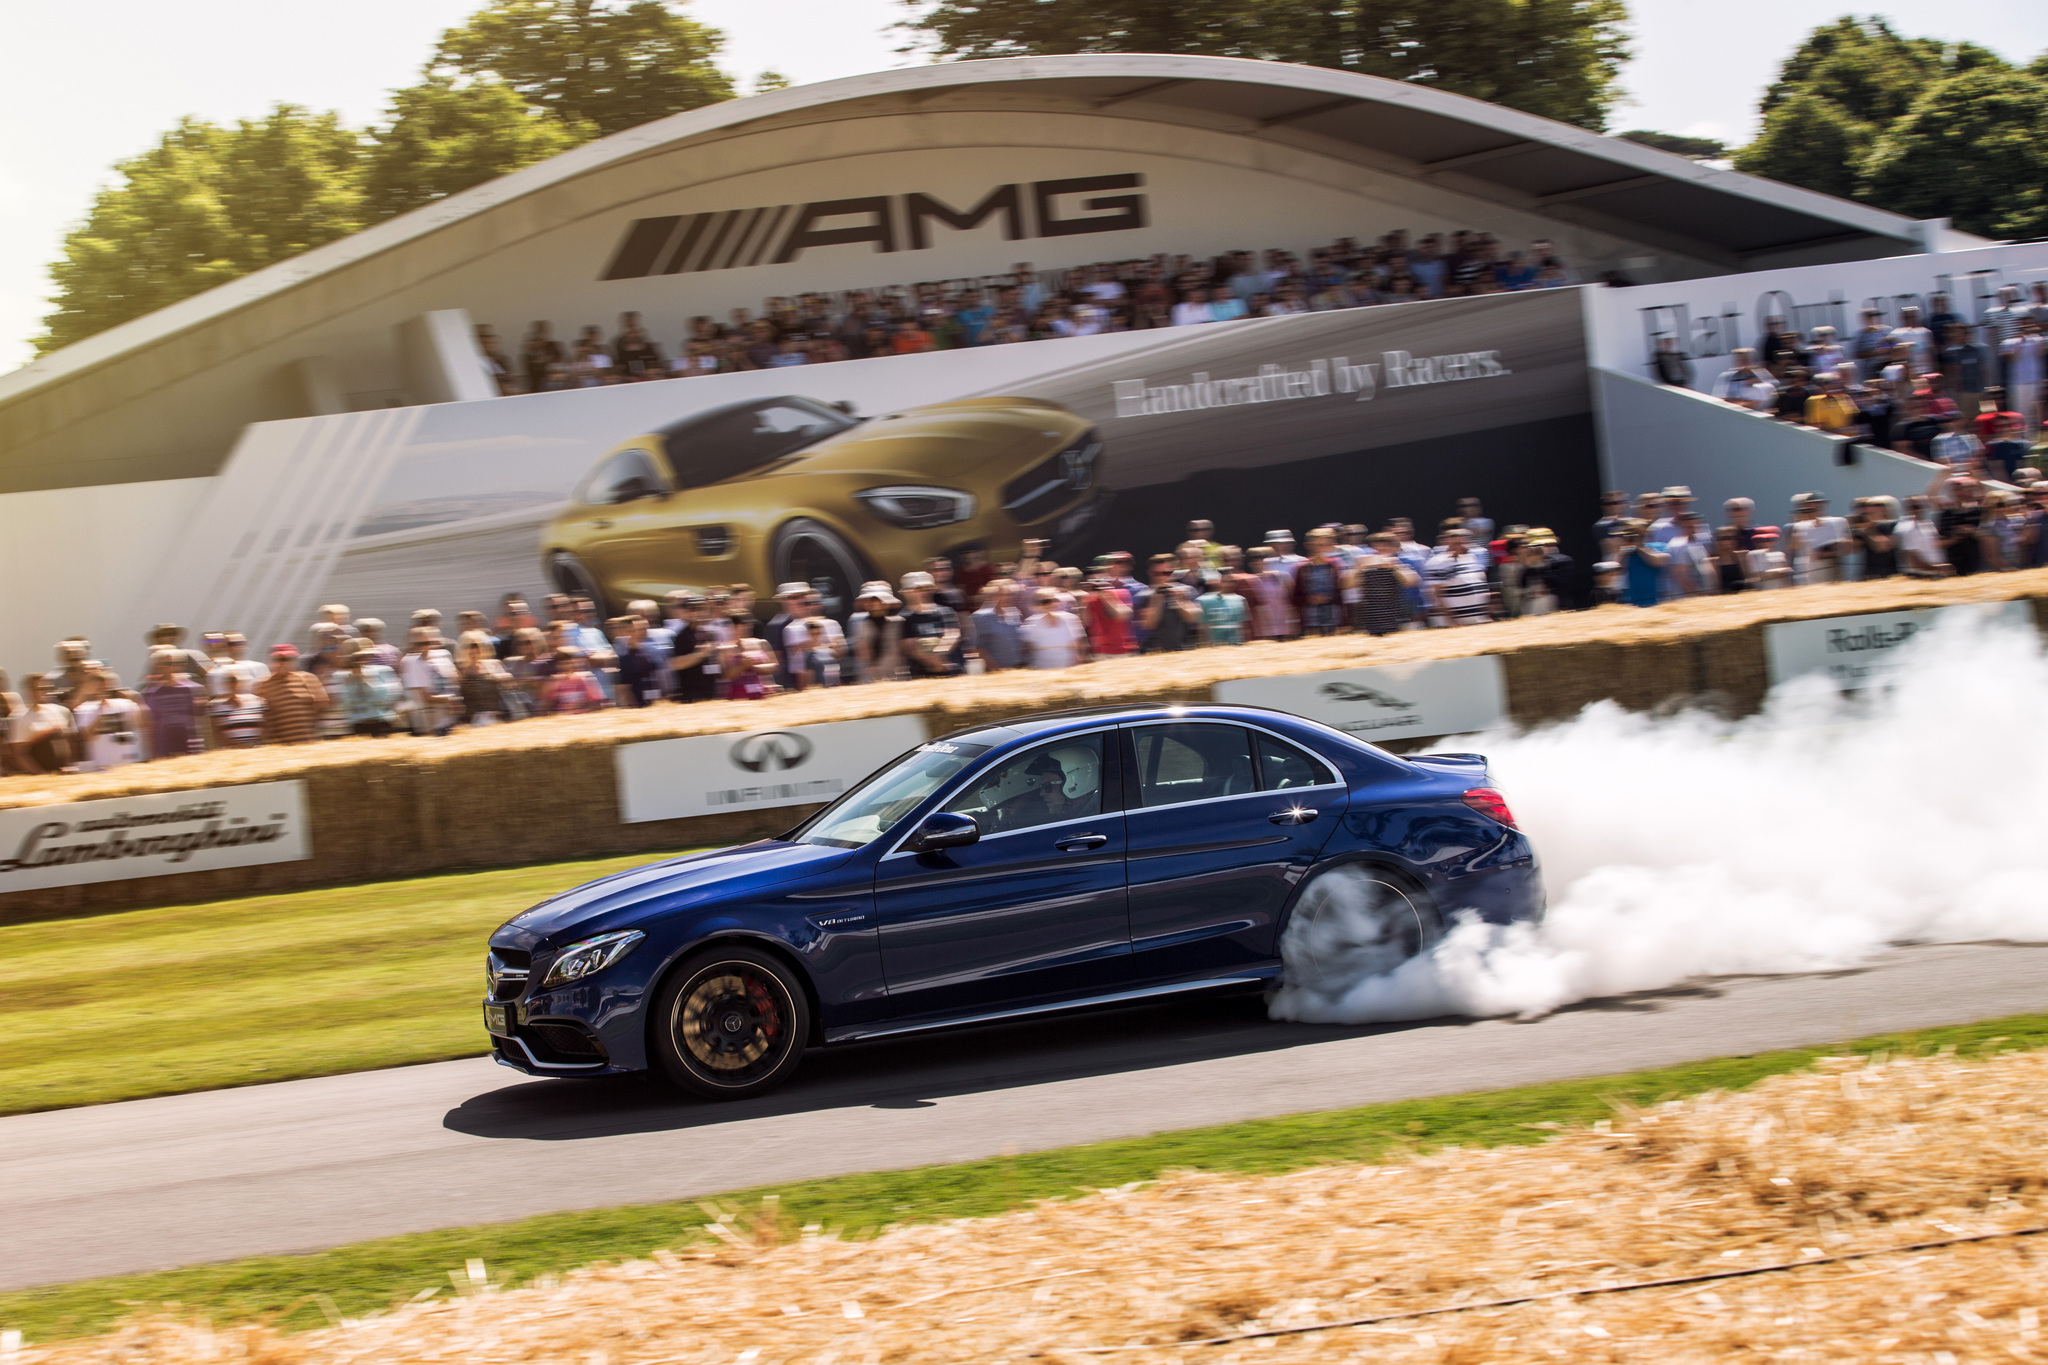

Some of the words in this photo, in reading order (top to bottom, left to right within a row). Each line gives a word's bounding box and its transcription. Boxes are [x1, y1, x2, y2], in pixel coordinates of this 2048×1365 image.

[774, 172, 1149, 264] AMG
[1113, 358, 1331, 418] Handcrafted
[1331, 356, 1380, 401] by
[1381, 350, 1513, 388] Racers.
[0, 812, 290, 873] Lamborghini
